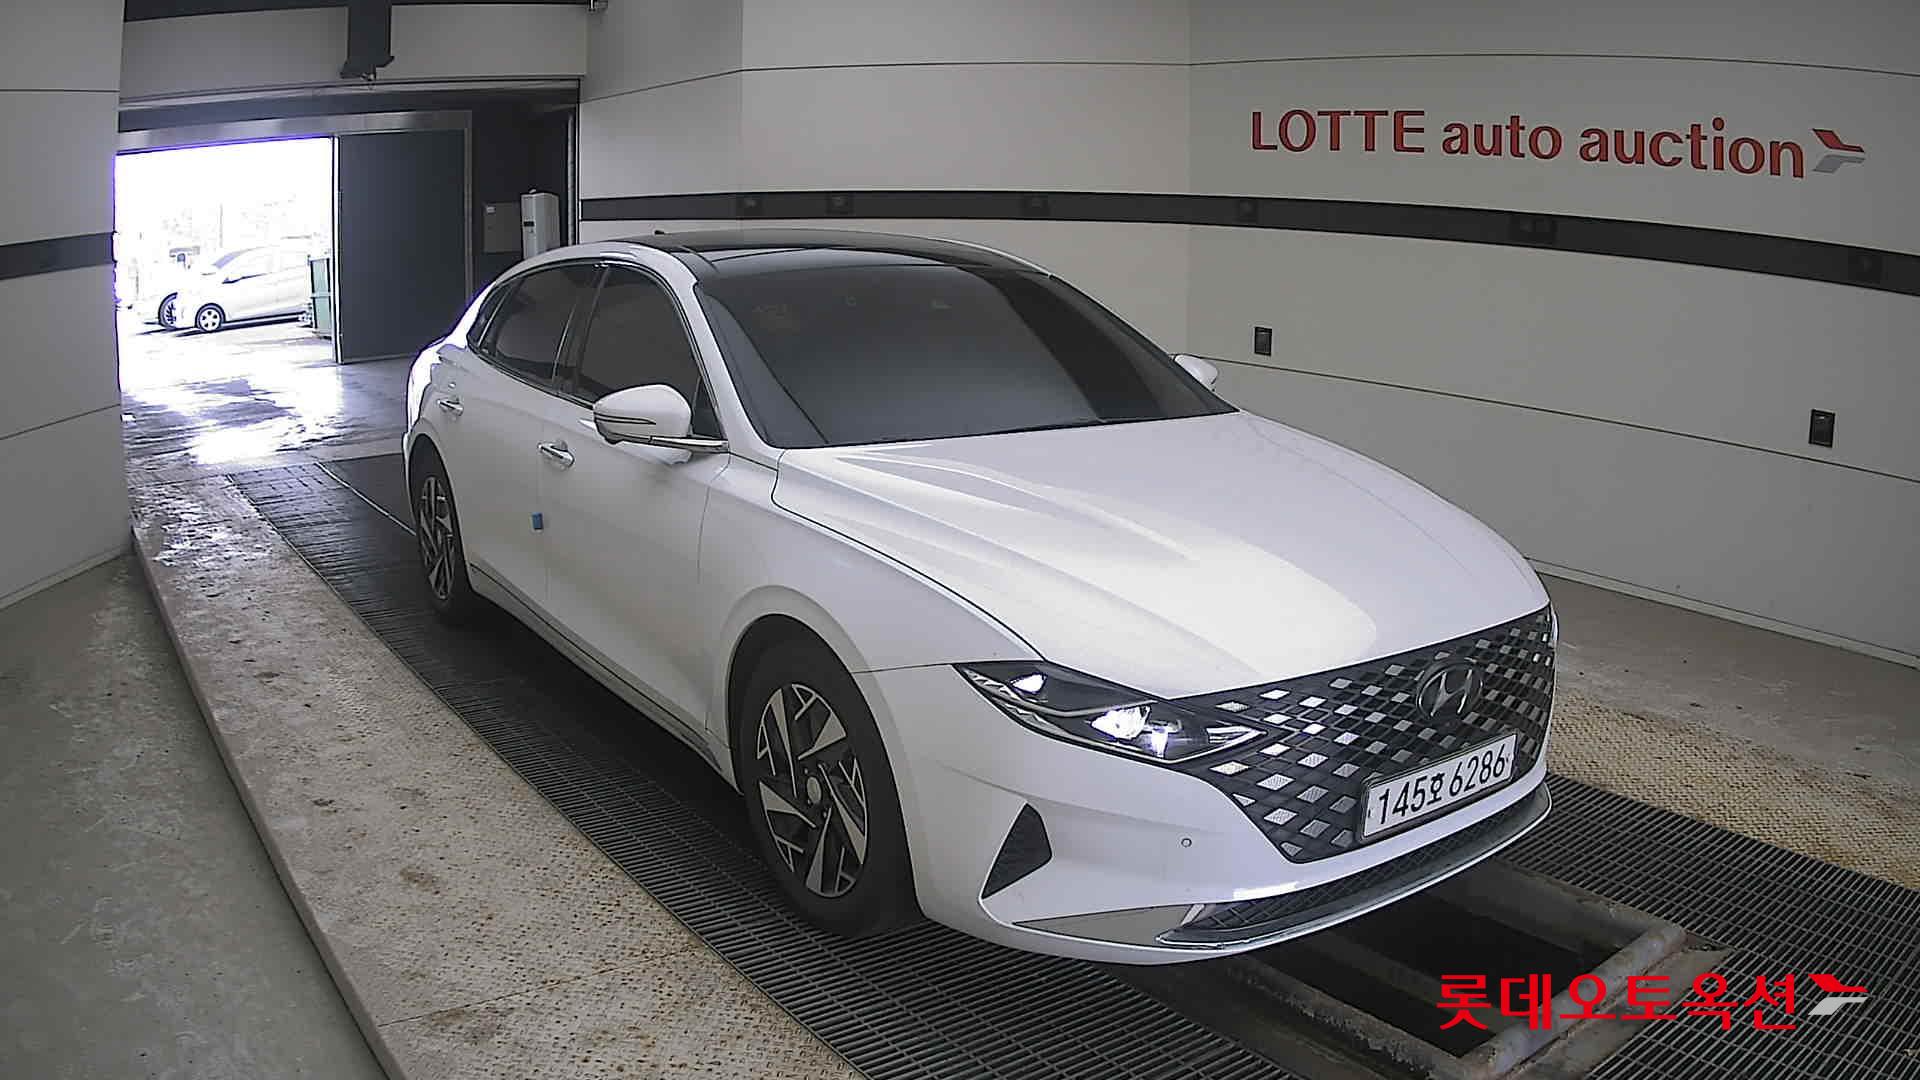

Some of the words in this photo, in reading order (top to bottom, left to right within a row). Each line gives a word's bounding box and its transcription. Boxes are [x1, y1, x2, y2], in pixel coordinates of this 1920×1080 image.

[1252, 110, 1425, 153] LOTTE
[1441, 115, 1562, 160] auto
[1578, 117, 1804, 179] auction
[1378, 772, 1445, 825] 145호
[1449, 743, 1506, 797] 6286
